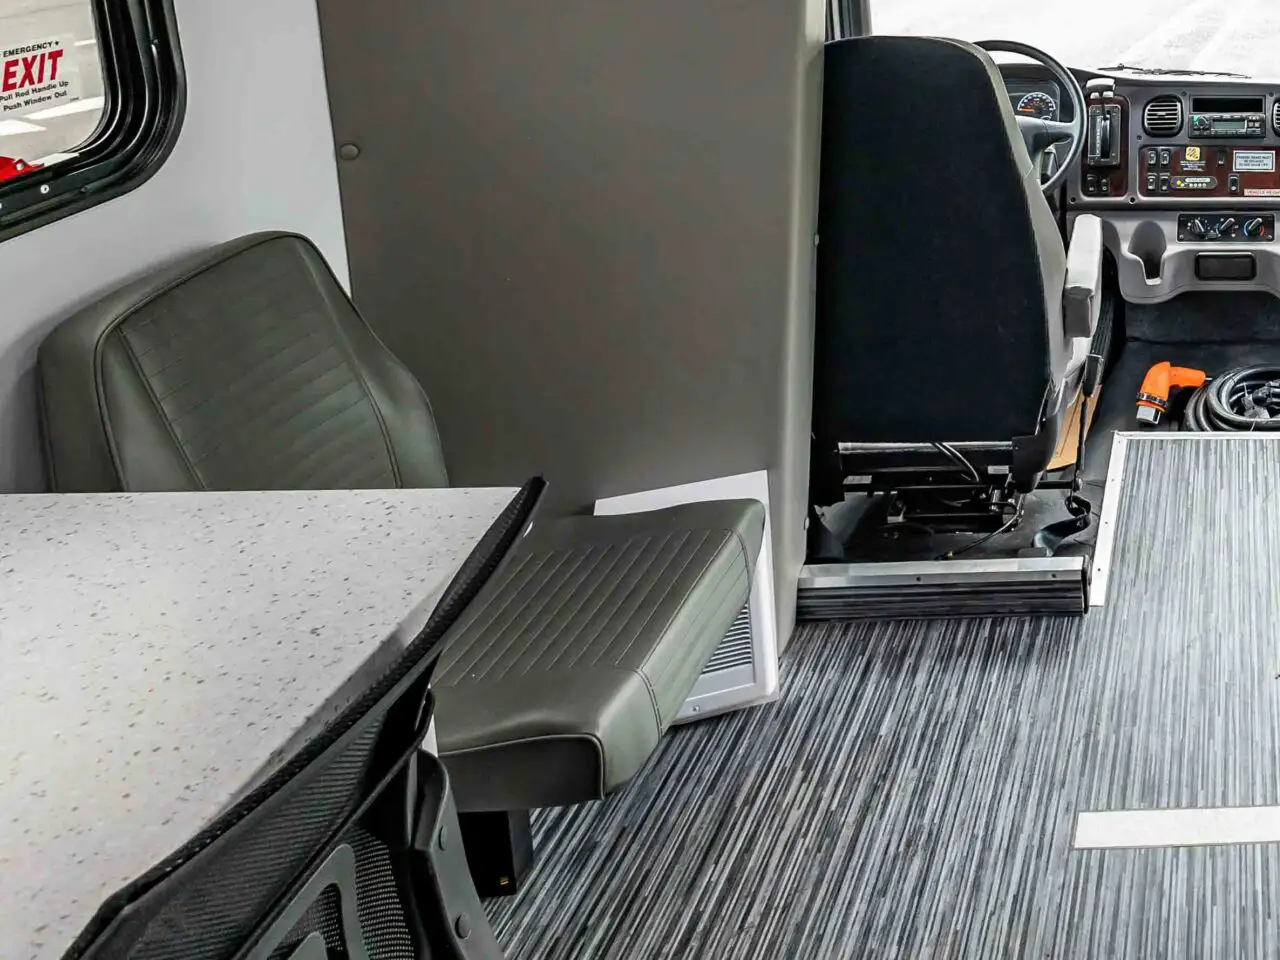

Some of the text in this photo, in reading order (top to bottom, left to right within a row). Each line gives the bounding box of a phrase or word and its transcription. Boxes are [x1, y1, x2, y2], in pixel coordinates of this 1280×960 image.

[3, 41, 53, 57] EMERGENCY
[2, 49, 64, 93] EXIT
[0, 93, 13, 102] Pull
[15, 90, 29, 98] Red
[32, 83, 57, 94] Handle
[3, 102, 22, 111] Push
[24, 95, 52, 106] Window
[54, 90, 67, 99] Out
